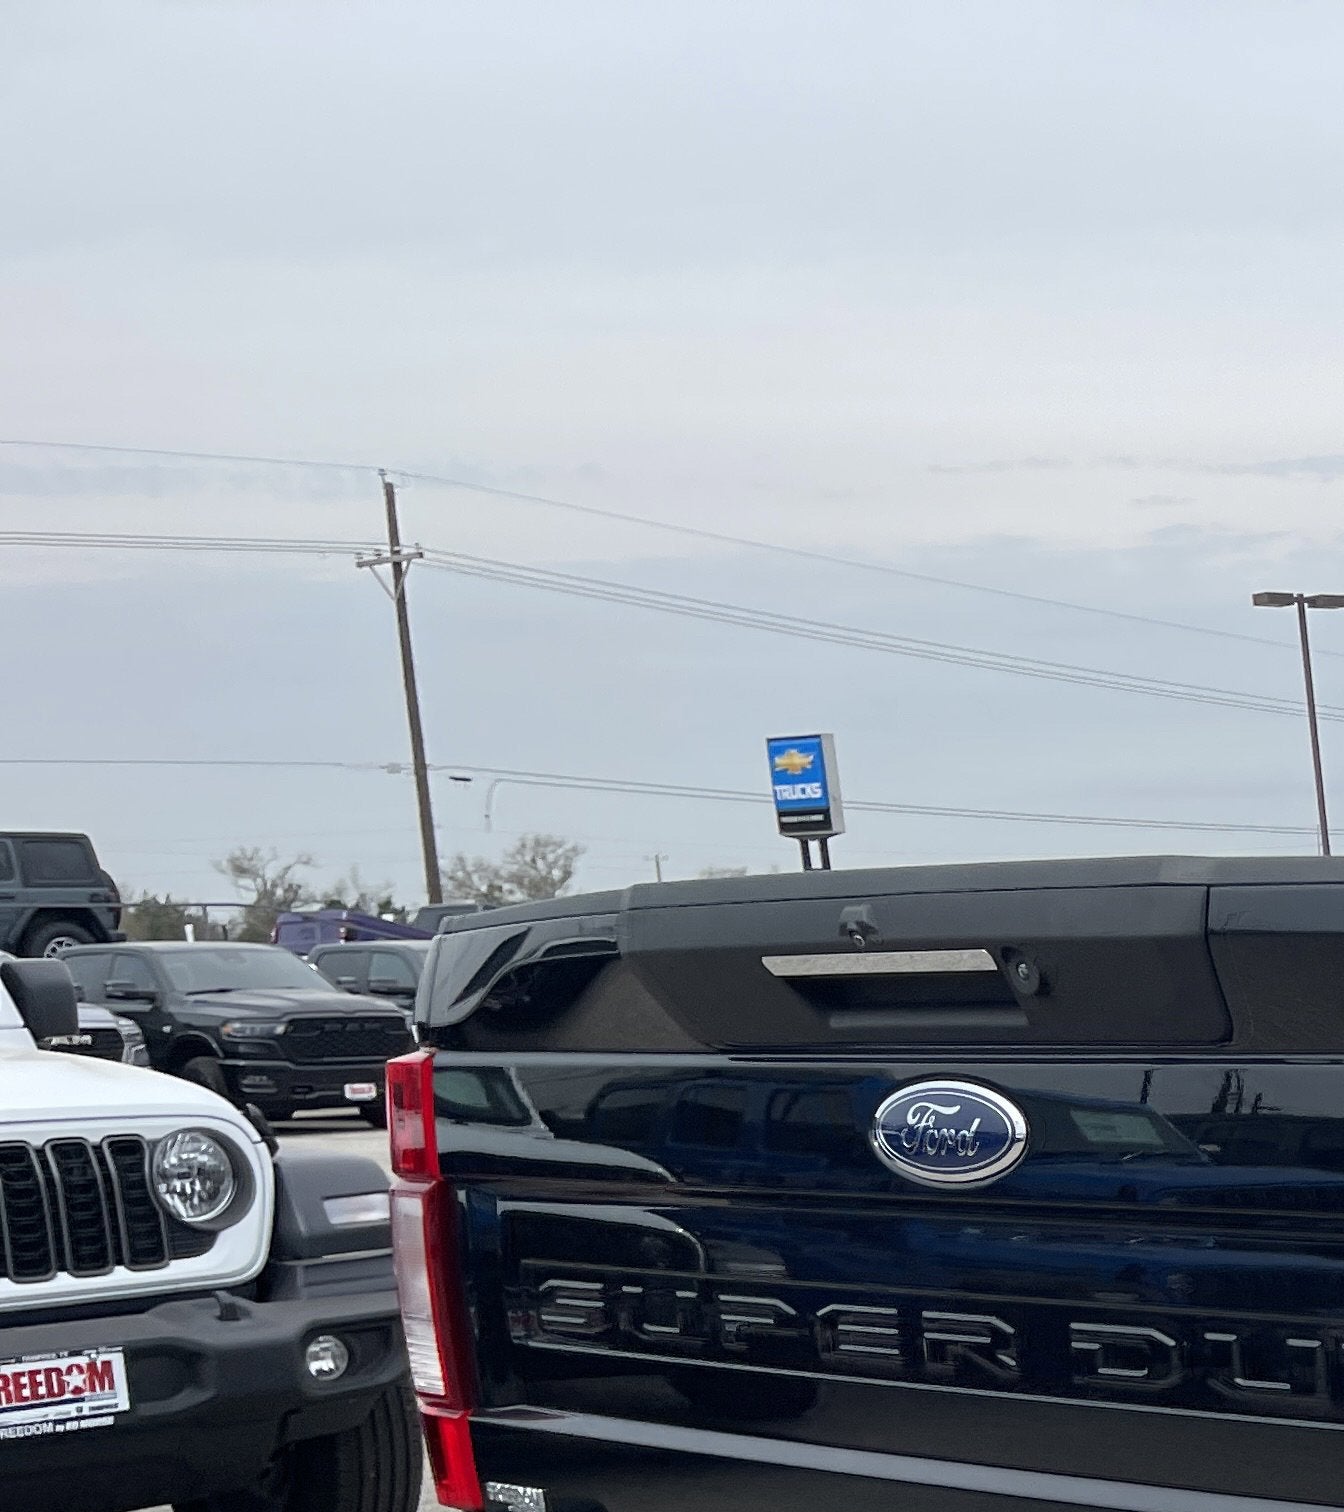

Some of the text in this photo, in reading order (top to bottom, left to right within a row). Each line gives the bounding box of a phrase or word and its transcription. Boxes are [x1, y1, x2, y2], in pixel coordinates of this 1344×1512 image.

[773, 783, 823, 801] TRUCKS
[900, 1101, 982, 1156] Ford
[536, 1278, 1021, 1379] SUPER
[0, 1360, 115, 1406] REEDOM
